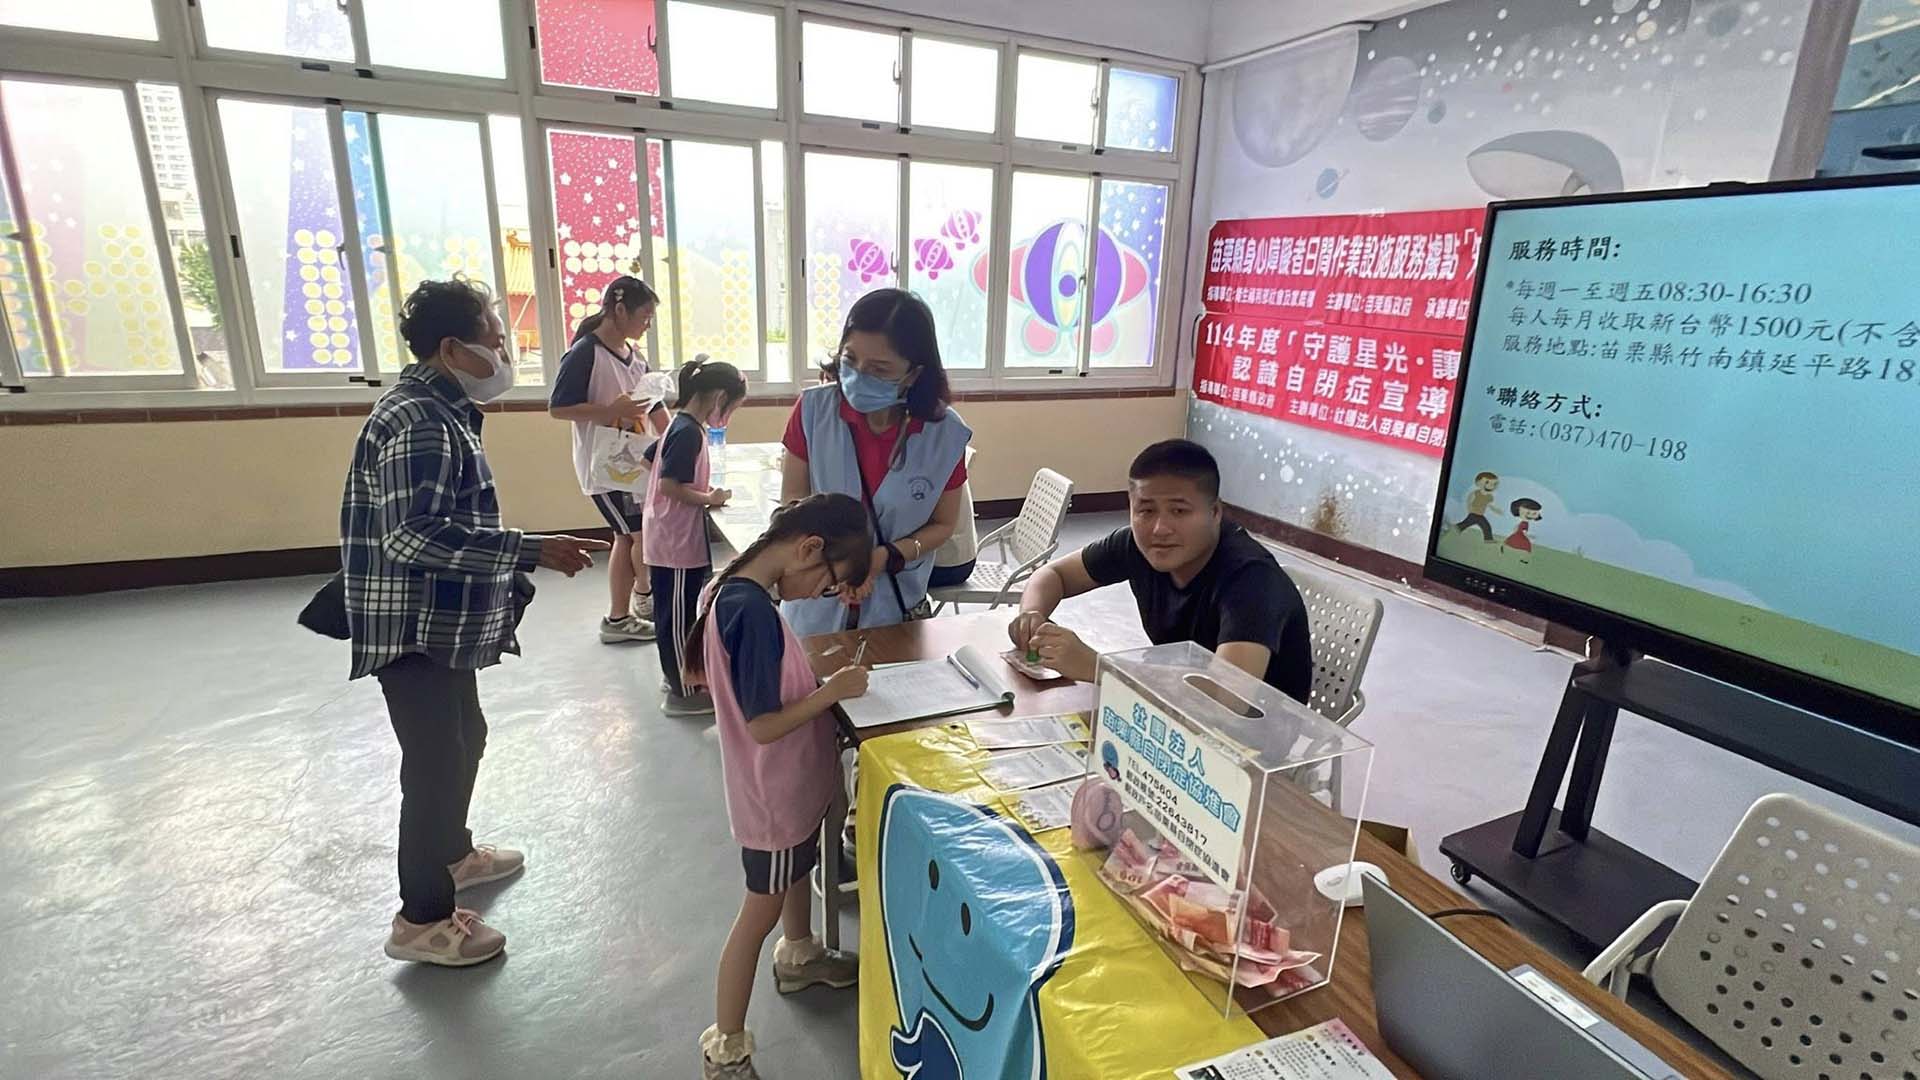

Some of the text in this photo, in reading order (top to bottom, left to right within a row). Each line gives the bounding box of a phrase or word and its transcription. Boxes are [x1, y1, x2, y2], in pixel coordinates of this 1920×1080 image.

[1508, 235, 1622, 261] 服務時間:
[1232, 355, 1449, 420] 認識自閉症宣導
[1502, 333, 1920, 382] 服務地點:苗栗縣竹南鎮延平路18
[1103, 706, 1240, 832] 苗栗縣自閉症協進會
[1132, 702, 1205, 777] 社團法人
